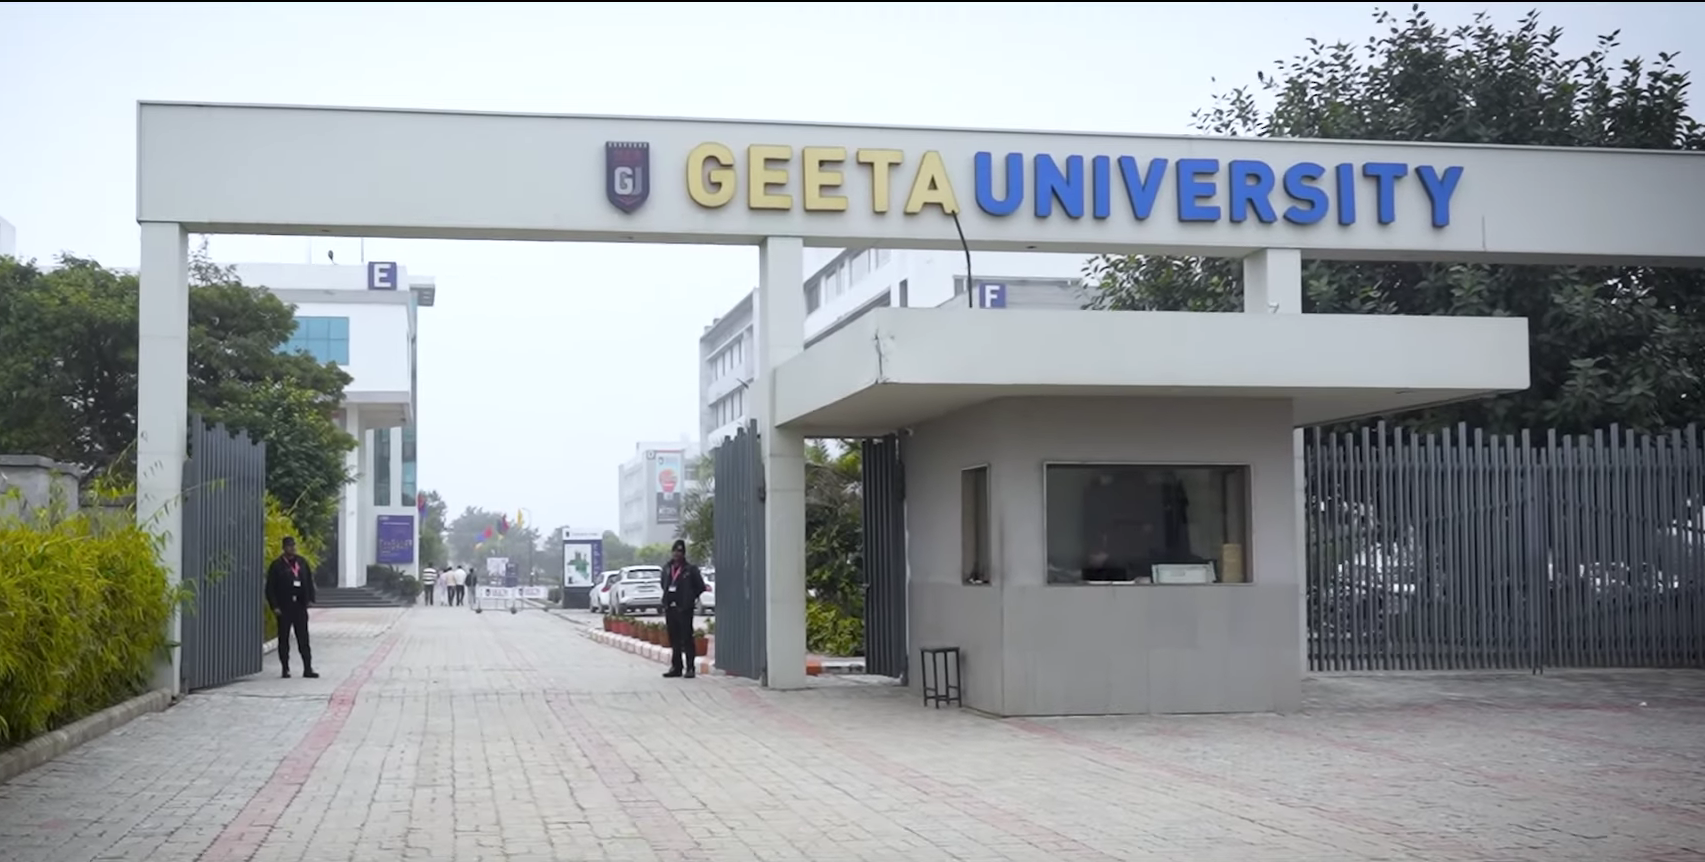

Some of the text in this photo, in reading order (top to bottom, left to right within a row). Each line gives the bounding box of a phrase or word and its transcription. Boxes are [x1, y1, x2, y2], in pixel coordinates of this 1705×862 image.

[686, 142, 1464, 228] GEETA UNIVERSITY
[374, 264, 391, 288] E
[985, 285, 1000, 308] F
